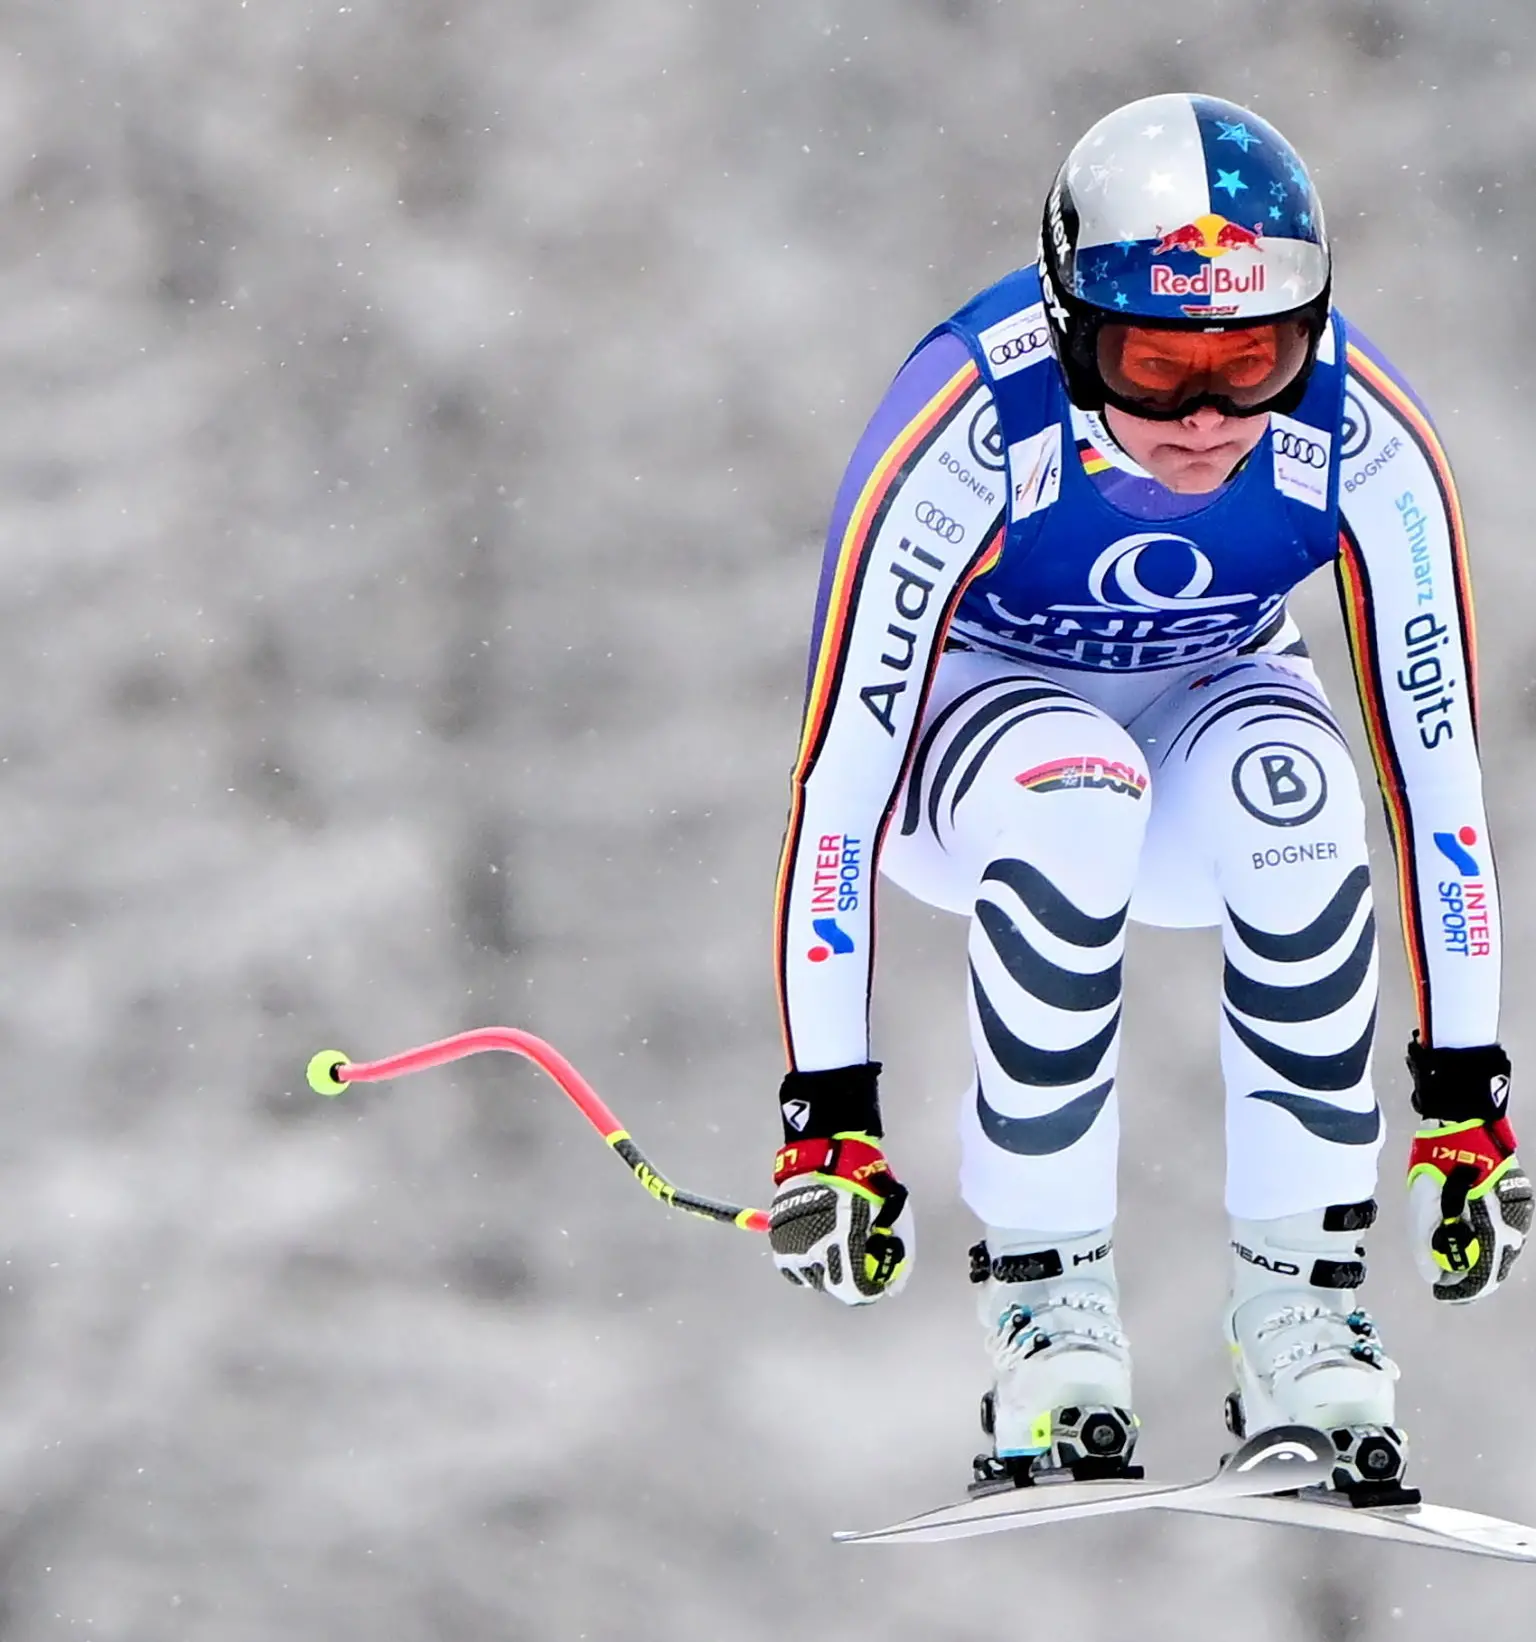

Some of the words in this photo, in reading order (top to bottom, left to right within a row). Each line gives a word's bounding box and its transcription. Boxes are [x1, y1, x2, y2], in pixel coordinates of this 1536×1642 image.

[1151, 264, 1210, 295] Red
[1214, 264, 1265, 294] Bull
[937, 450, 997, 507] BOGNER
[1343, 435, 1404, 493] BOGNER
[1395, 490, 1435, 606] schwarz
[859, 537, 946, 738] Audi
[1397, 612, 1456, 750] digits
[811, 834, 841, 913] INTER
[838, 834, 861, 912] SPORT
[1252, 842, 1338, 869] BOGNER
[1438, 880, 1469, 957] SPORT
[1463, 883, 1490, 957] INTER
[853, 1160, 887, 1180] EKI
[1432, 1145, 1494, 1170] LEKI
[1231, 1239, 1301, 1277] HEAD
